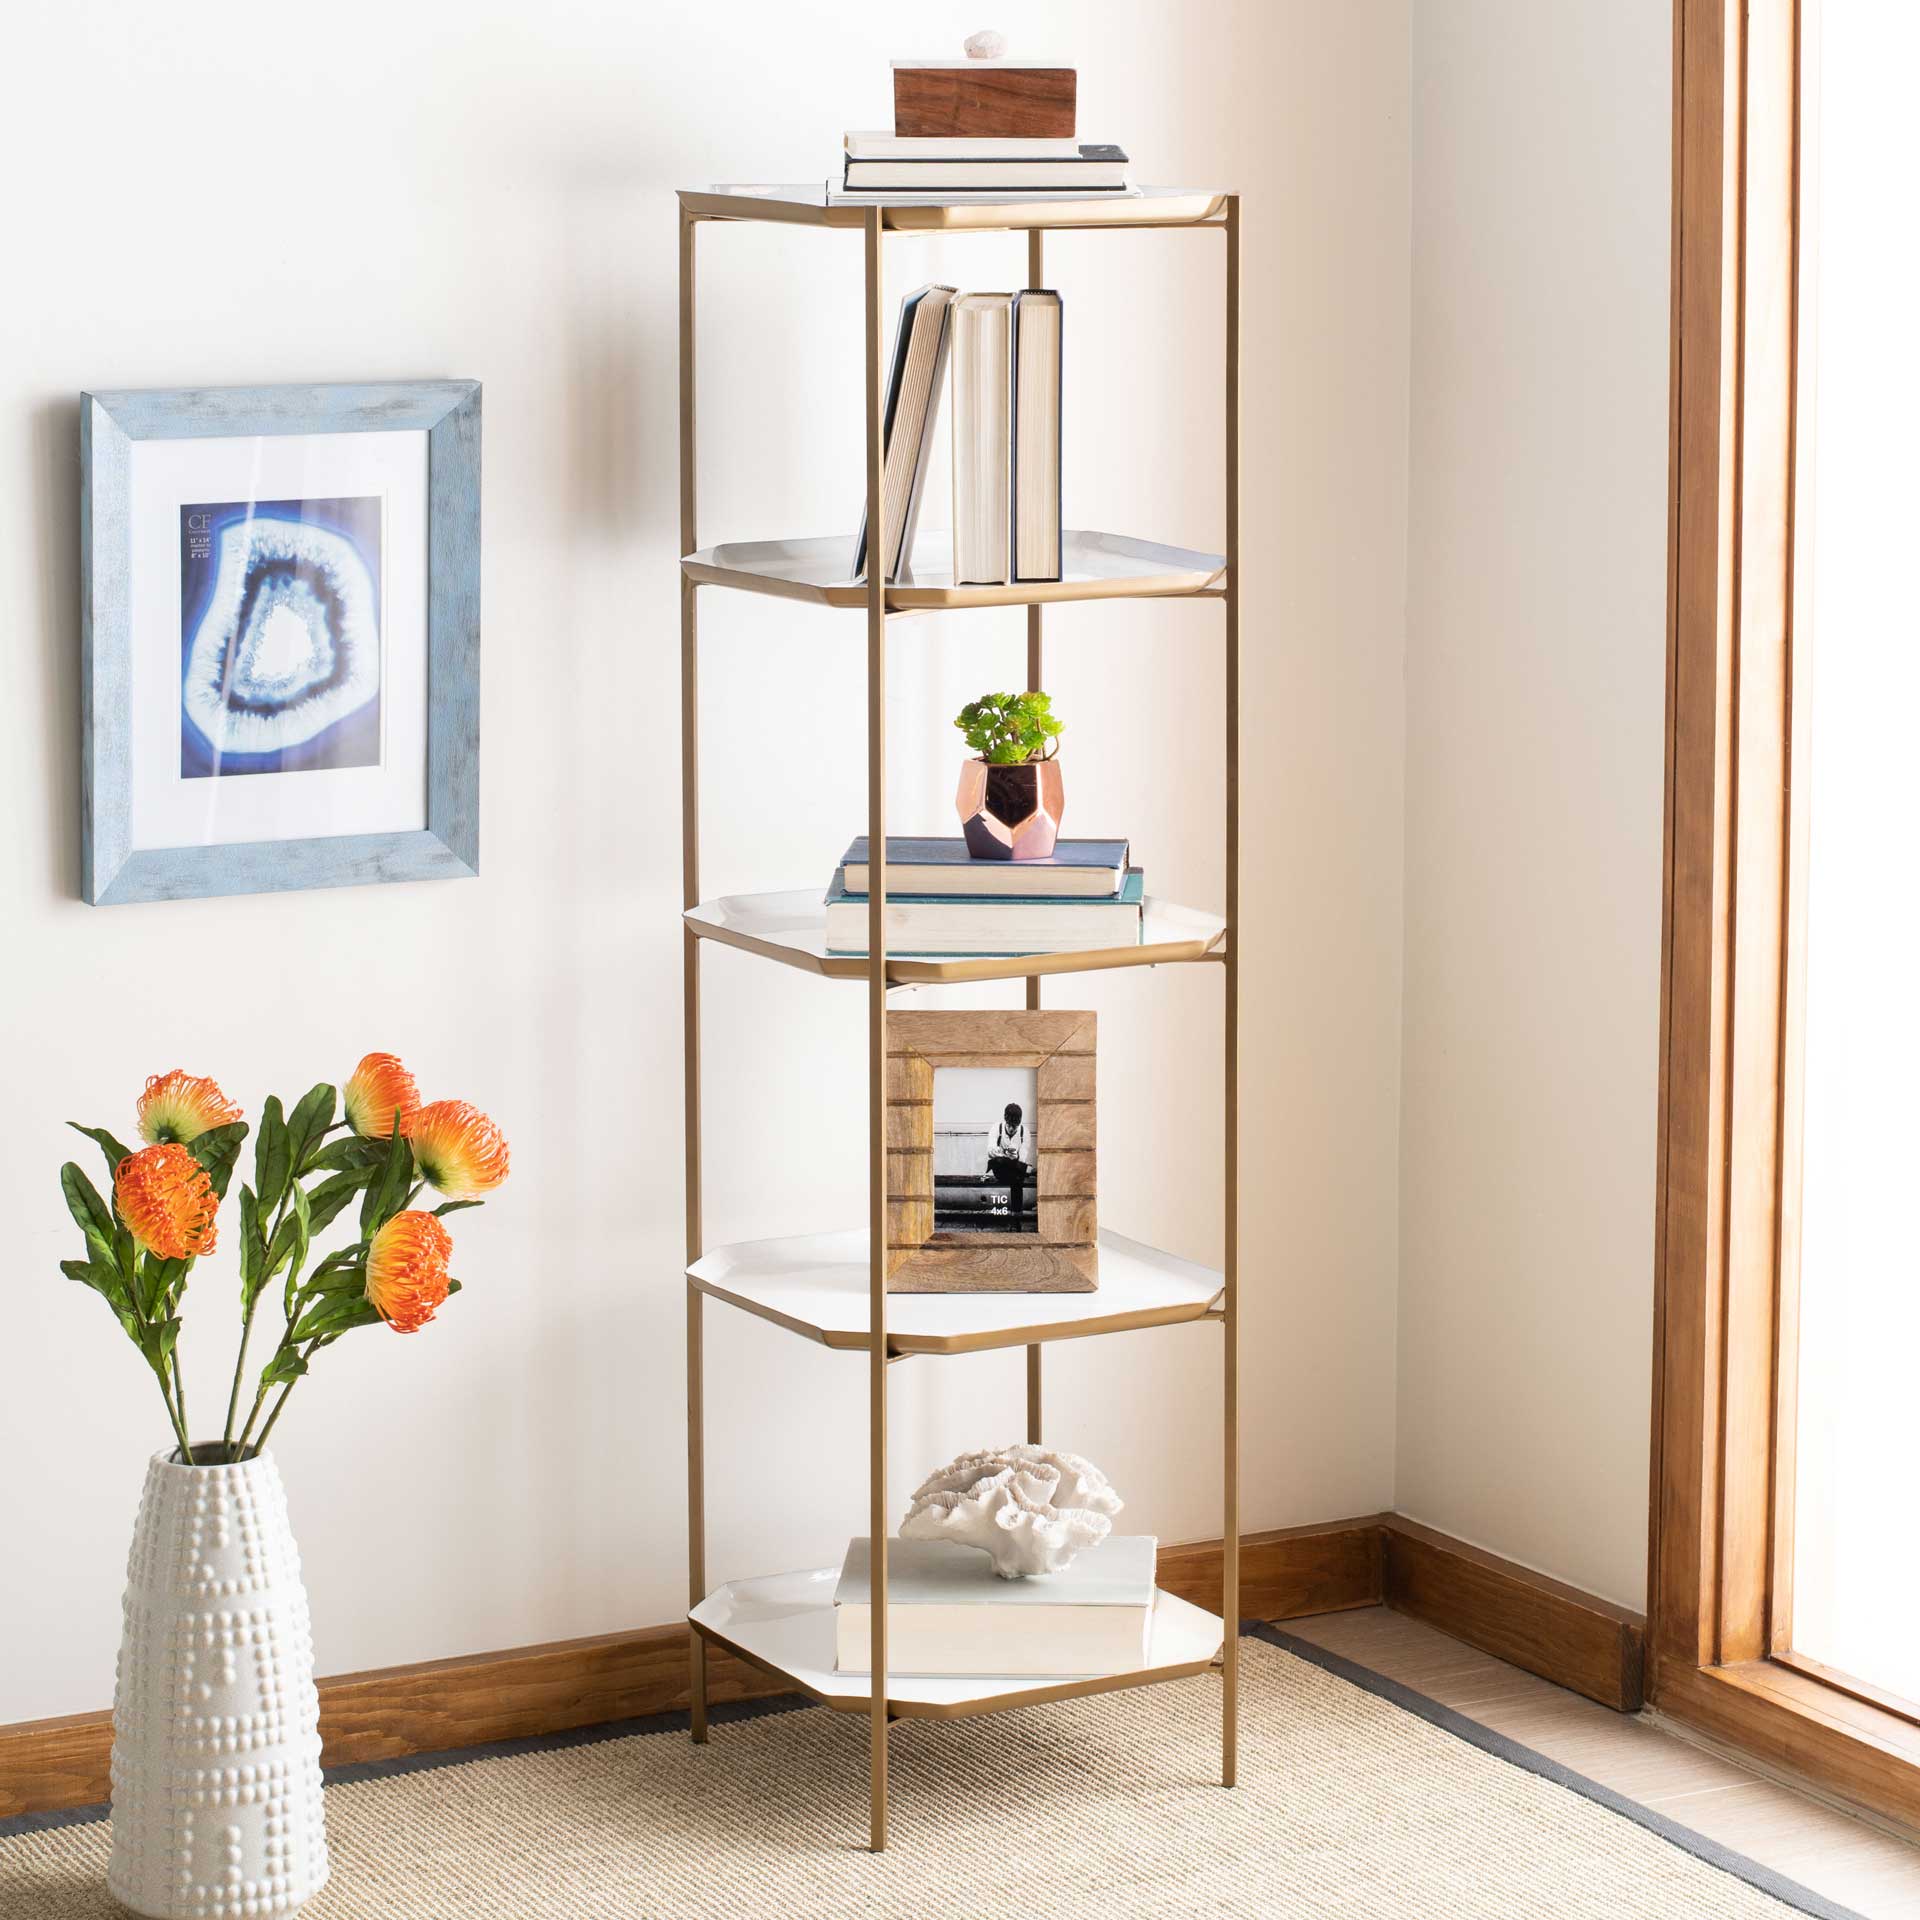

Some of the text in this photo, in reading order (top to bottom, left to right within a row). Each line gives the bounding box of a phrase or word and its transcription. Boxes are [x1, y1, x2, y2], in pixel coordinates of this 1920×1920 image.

[188, 514, 211, 529] CF
[990, 1195, 1008, 1204] TIC
[991, 1206, 1008, 1215] 4x6
